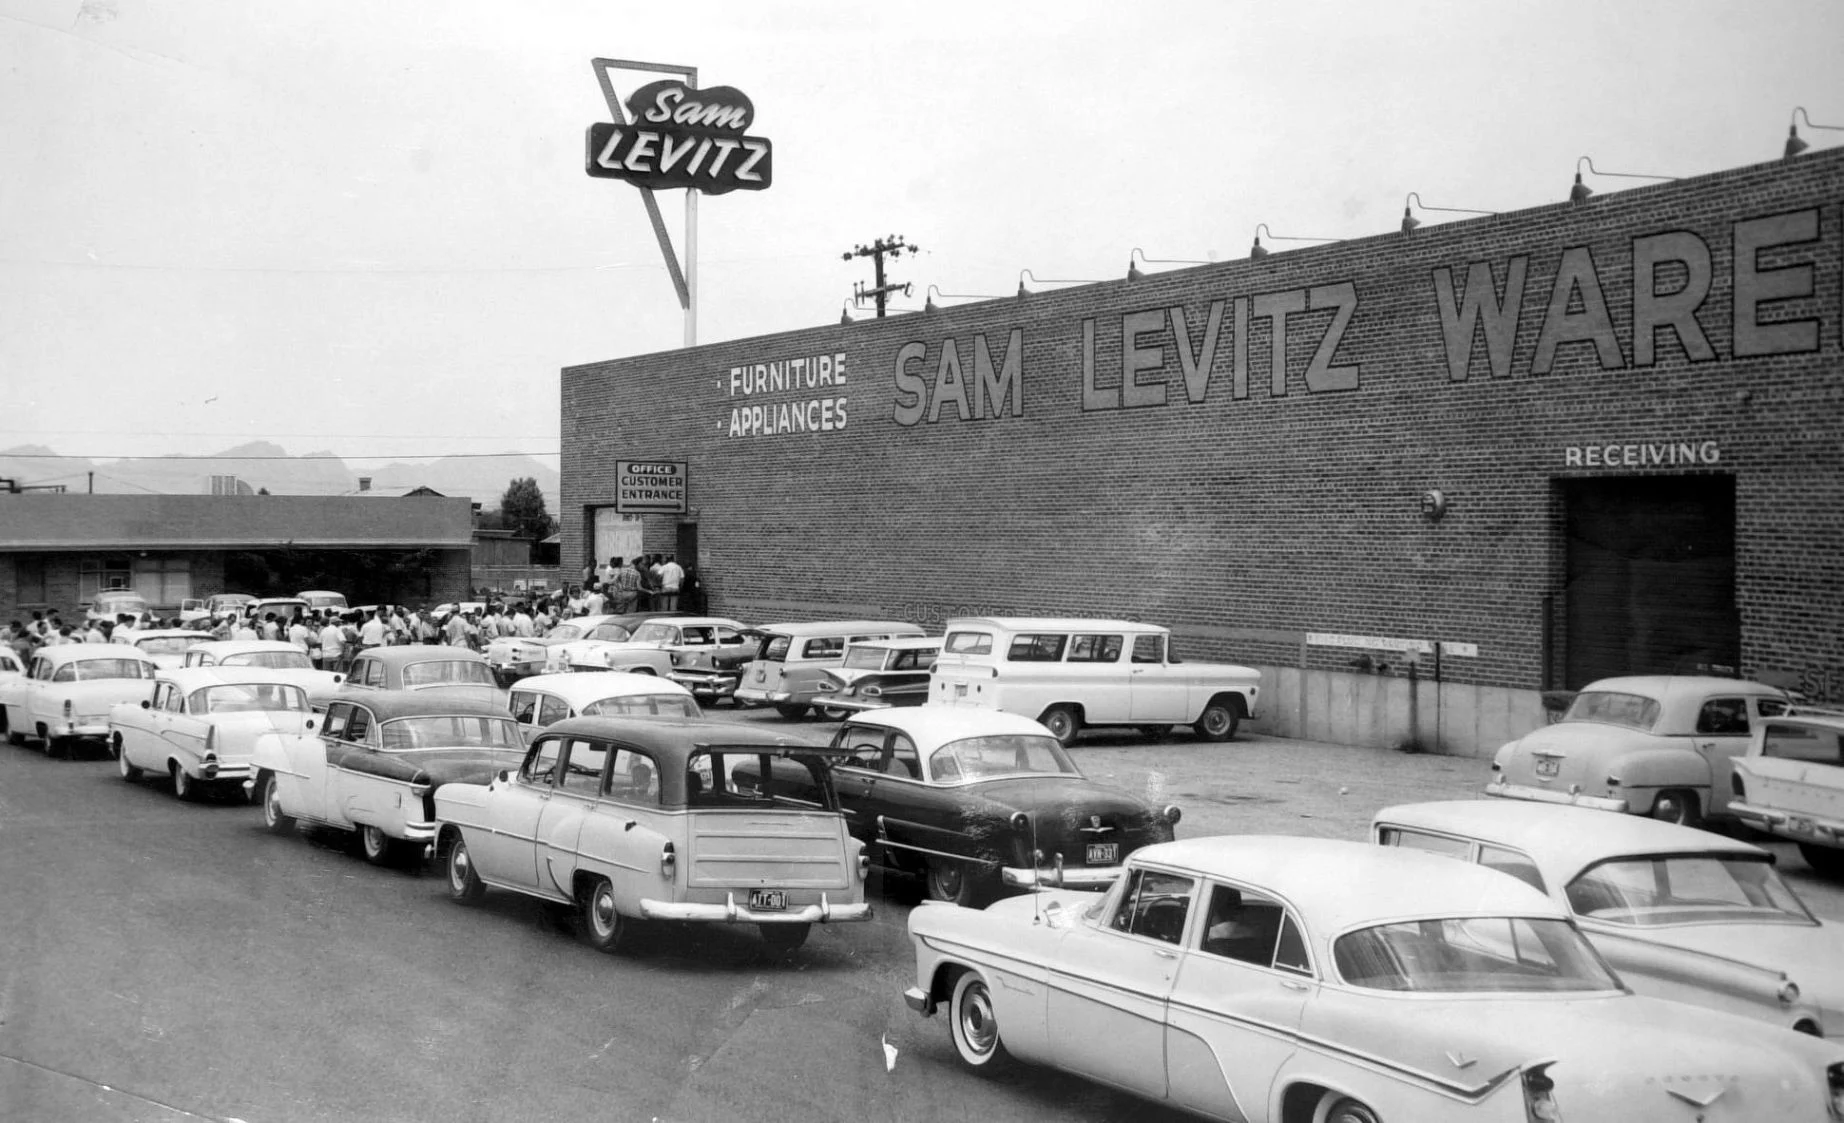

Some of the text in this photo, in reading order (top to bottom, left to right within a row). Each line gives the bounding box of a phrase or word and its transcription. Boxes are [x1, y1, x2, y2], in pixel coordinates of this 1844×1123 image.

[645, 87, 747, 129] Sam
[597, 129, 768, 182] LEVITZ
[892, 206, 1844, 427] SAM LEVITZ WARE
[730, 353, 846, 396] FURNITURE
[729, 397, 847, 437] APPLIANCES
[631, 464, 672, 474] OFFICE
[1565, 440, 1721, 467] RECEIVING
[621, 475, 683, 487] CUSTOMER
[621, 489, 683, 500] ENTRANCE
